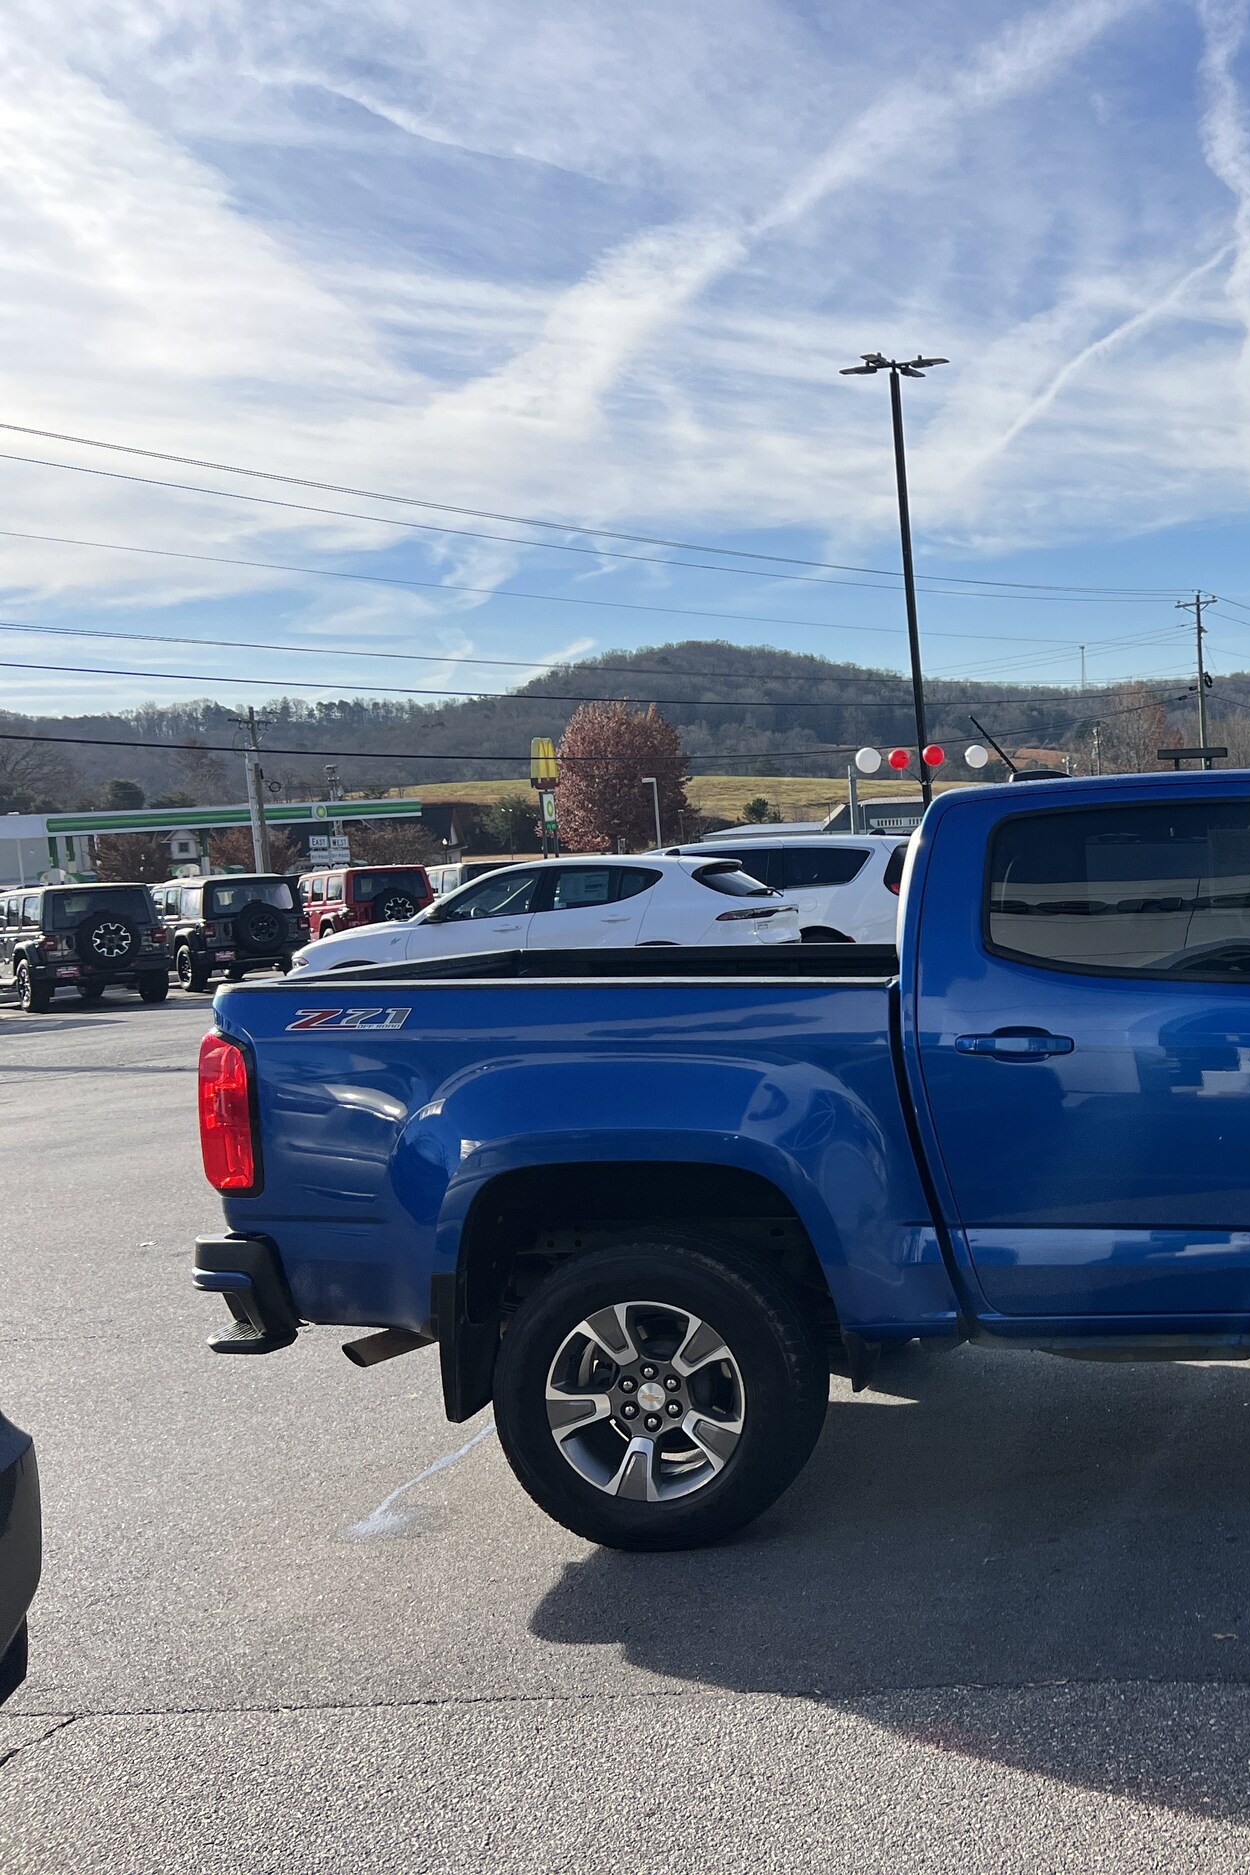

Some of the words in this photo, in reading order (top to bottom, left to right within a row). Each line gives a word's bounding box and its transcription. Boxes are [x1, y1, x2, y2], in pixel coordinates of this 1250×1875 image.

[311, 837, 326, 846] EAST
[331, 838, 348, 847] WEST
[284, 1007, 412, 1031] Z71
